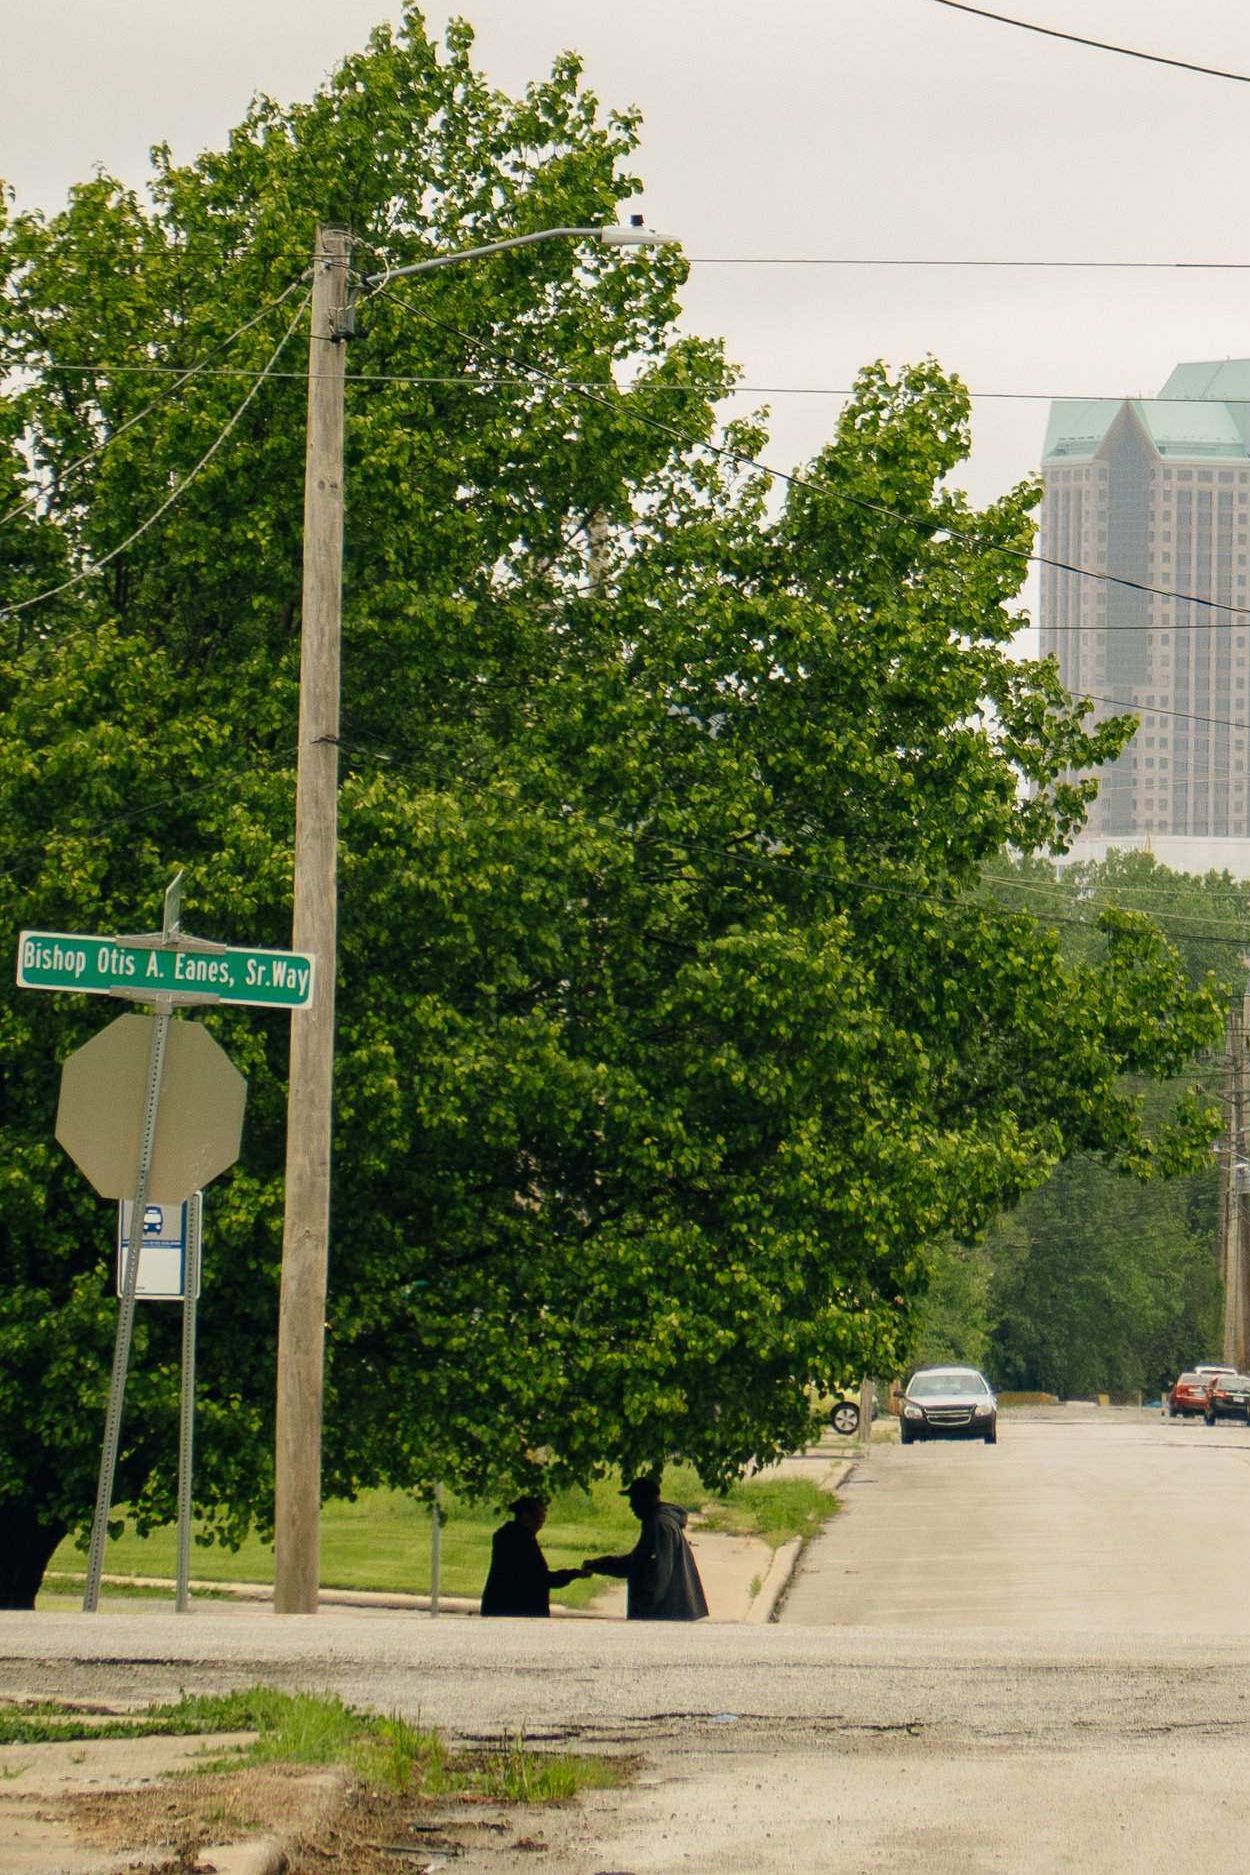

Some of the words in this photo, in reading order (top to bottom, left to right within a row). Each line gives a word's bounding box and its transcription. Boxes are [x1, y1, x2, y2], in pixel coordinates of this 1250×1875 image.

[24, 941, 86, 979] Bishop
[97, 947, 135, 976] Otis
[145, 951, 165, 978] A.
[174, 953, 234, 988] Eanes,
